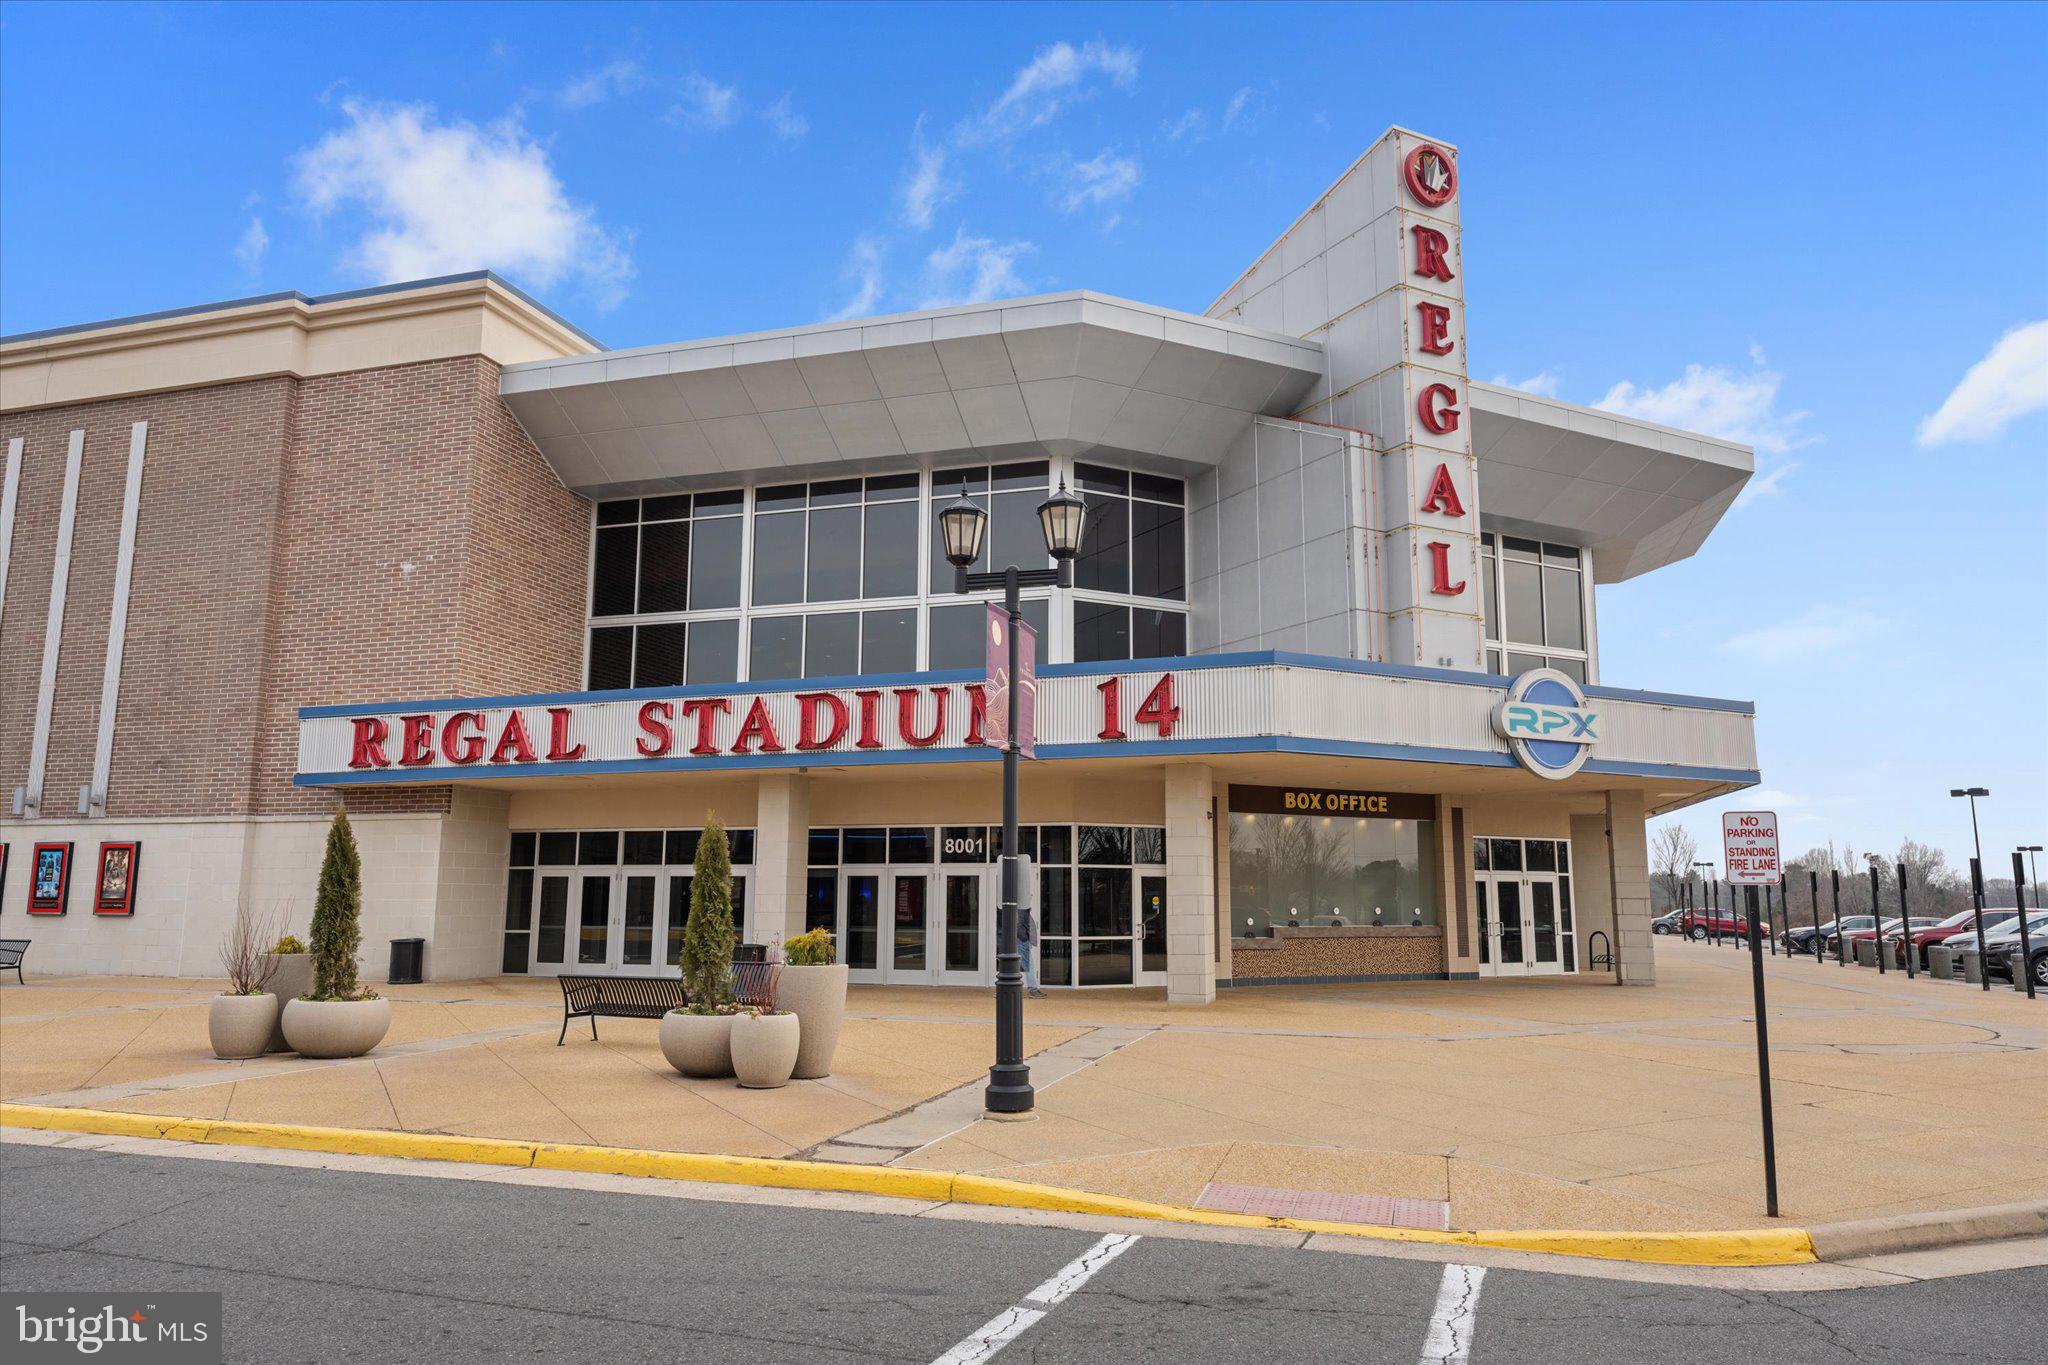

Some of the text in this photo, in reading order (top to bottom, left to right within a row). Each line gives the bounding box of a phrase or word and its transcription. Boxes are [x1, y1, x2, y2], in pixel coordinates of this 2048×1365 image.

[1410, 223, 1468, 597] REGAL
[348, 707, 586, 768] REGAL
[1096, 672, 1180, 740] 14
[1508, 706, 1598, 739] RPX
[1285, 792, 1388, 813] BOX OFFICE
[1740, 816, 1759, 827] NO
[1727, 828, 1774, 838] PARKING
[945, 838, 983, 854] 8001
[1728, 847, 1775, 857] STANDING
[1729, 859, 1776, 870] FIRE LANE
